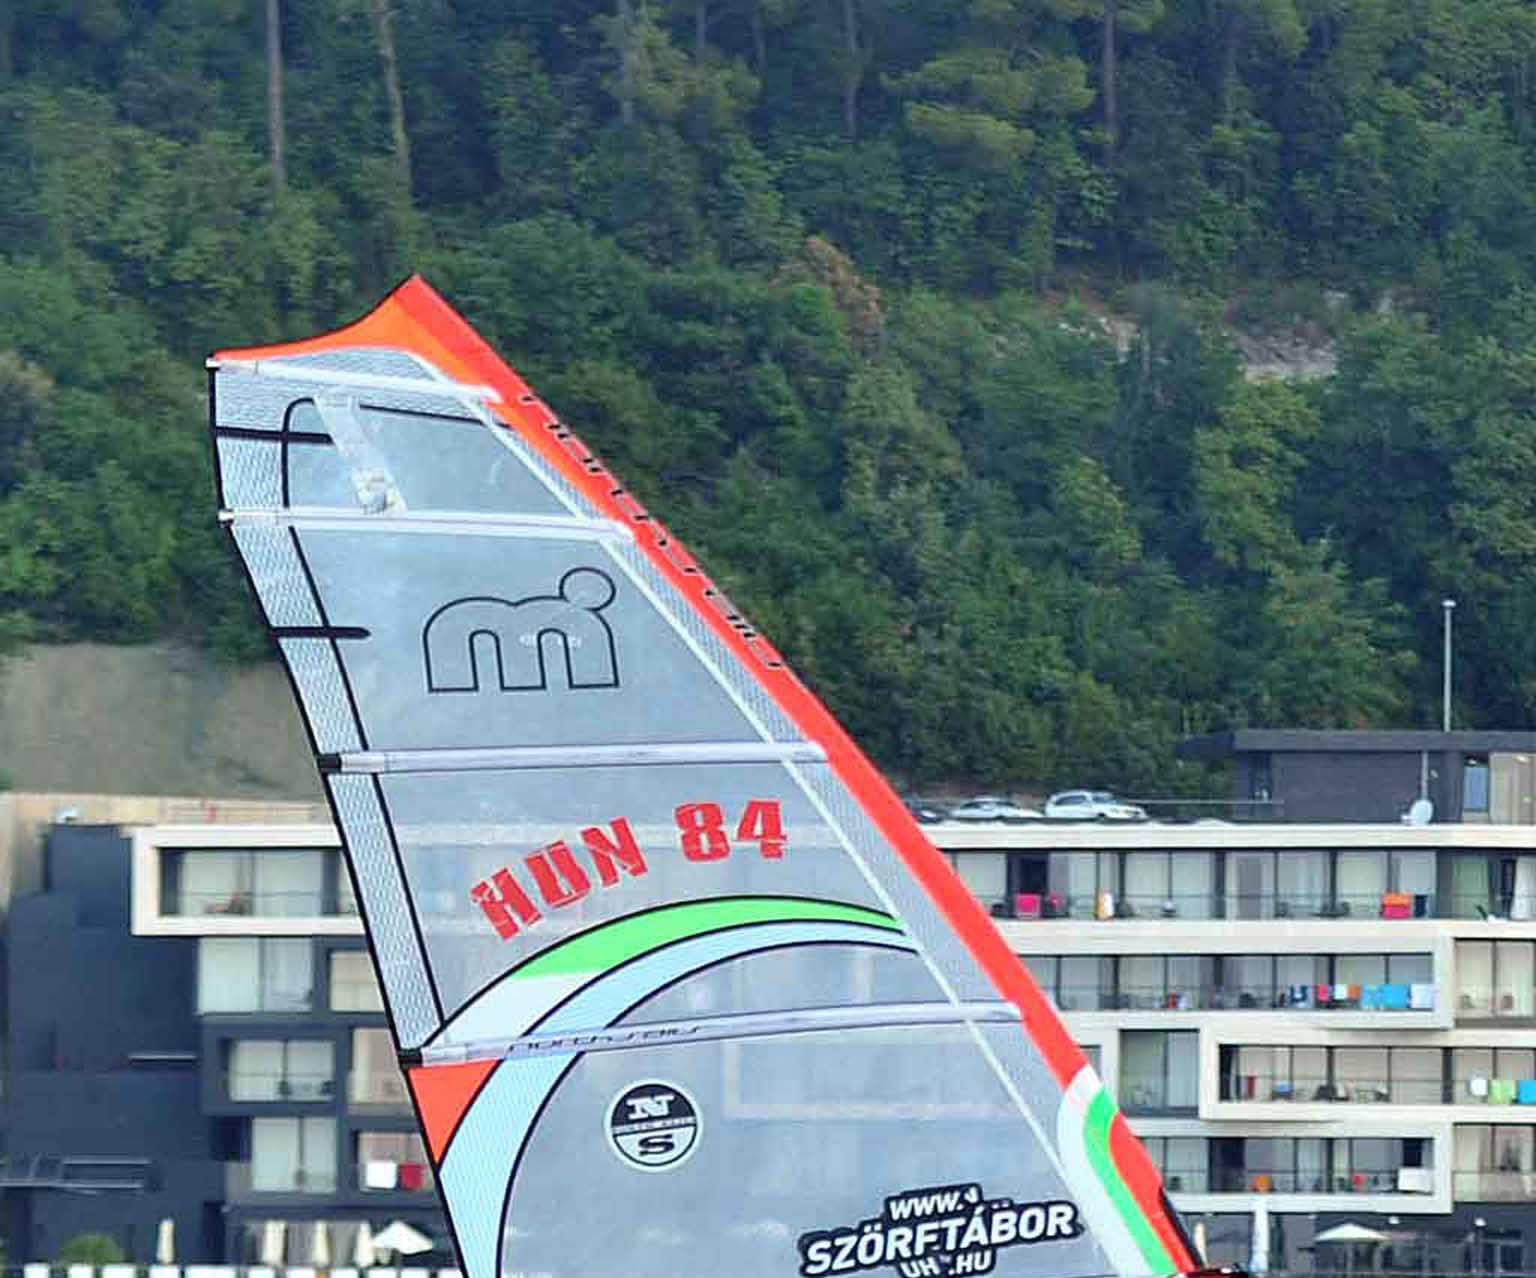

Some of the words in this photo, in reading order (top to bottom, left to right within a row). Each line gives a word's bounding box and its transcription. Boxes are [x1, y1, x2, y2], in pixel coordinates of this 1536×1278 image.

[470, 816, 648, 942] HUN
[674, 798, 788, 862] 84
[805, 1200, 1075, 1275] SZÖRFTÁBOR
